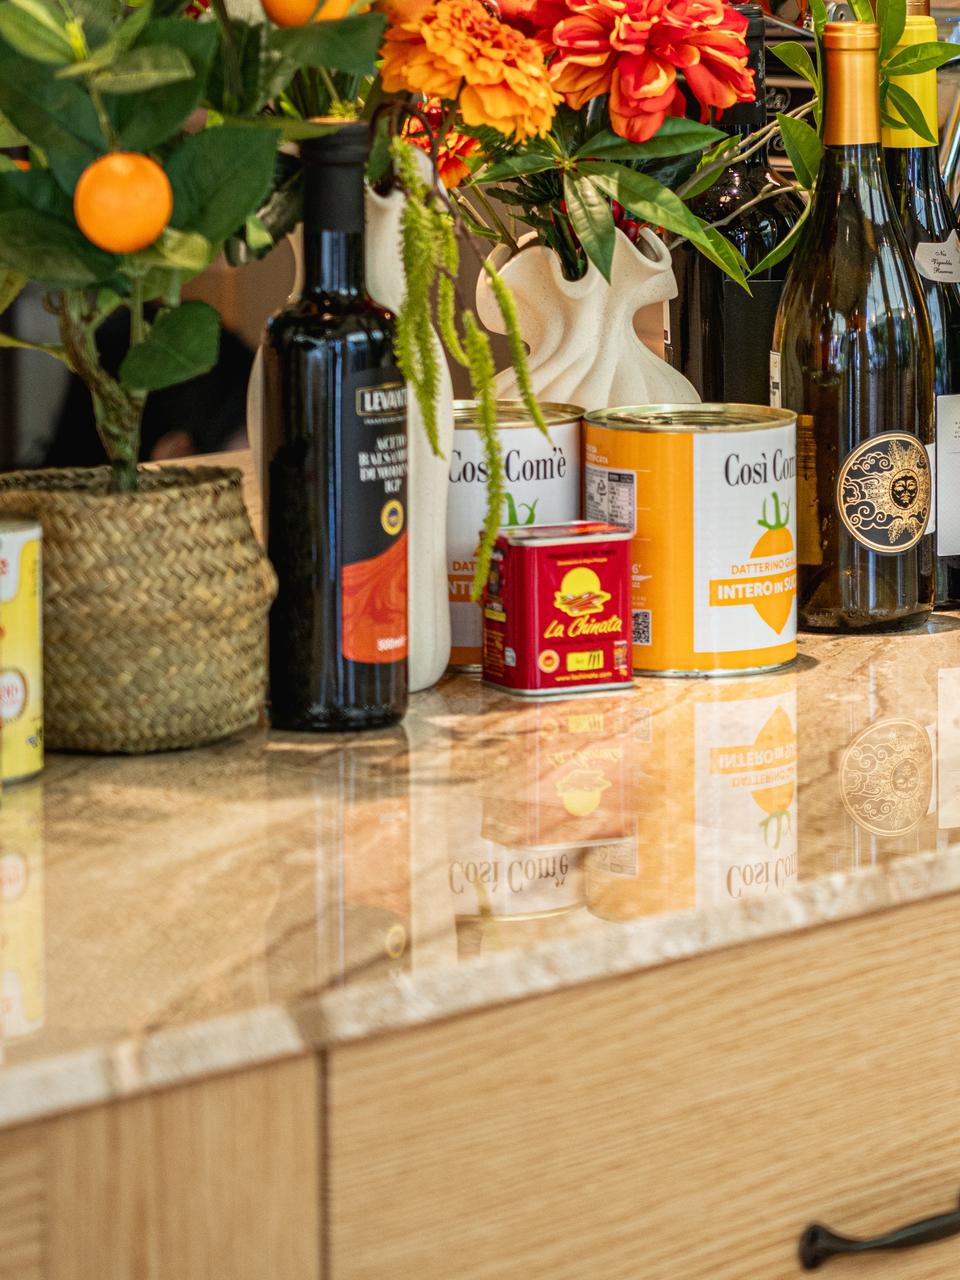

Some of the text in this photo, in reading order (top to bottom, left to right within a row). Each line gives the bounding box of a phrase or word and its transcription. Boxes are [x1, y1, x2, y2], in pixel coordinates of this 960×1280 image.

[449, 449, 489, 484] Cos
[724, 453, 768, 487] Così
[731, 560, 785, 576] DATTERINO
[717, 580, 773, 600] INTERO
[543, 614, 623, 639] La Chinata
